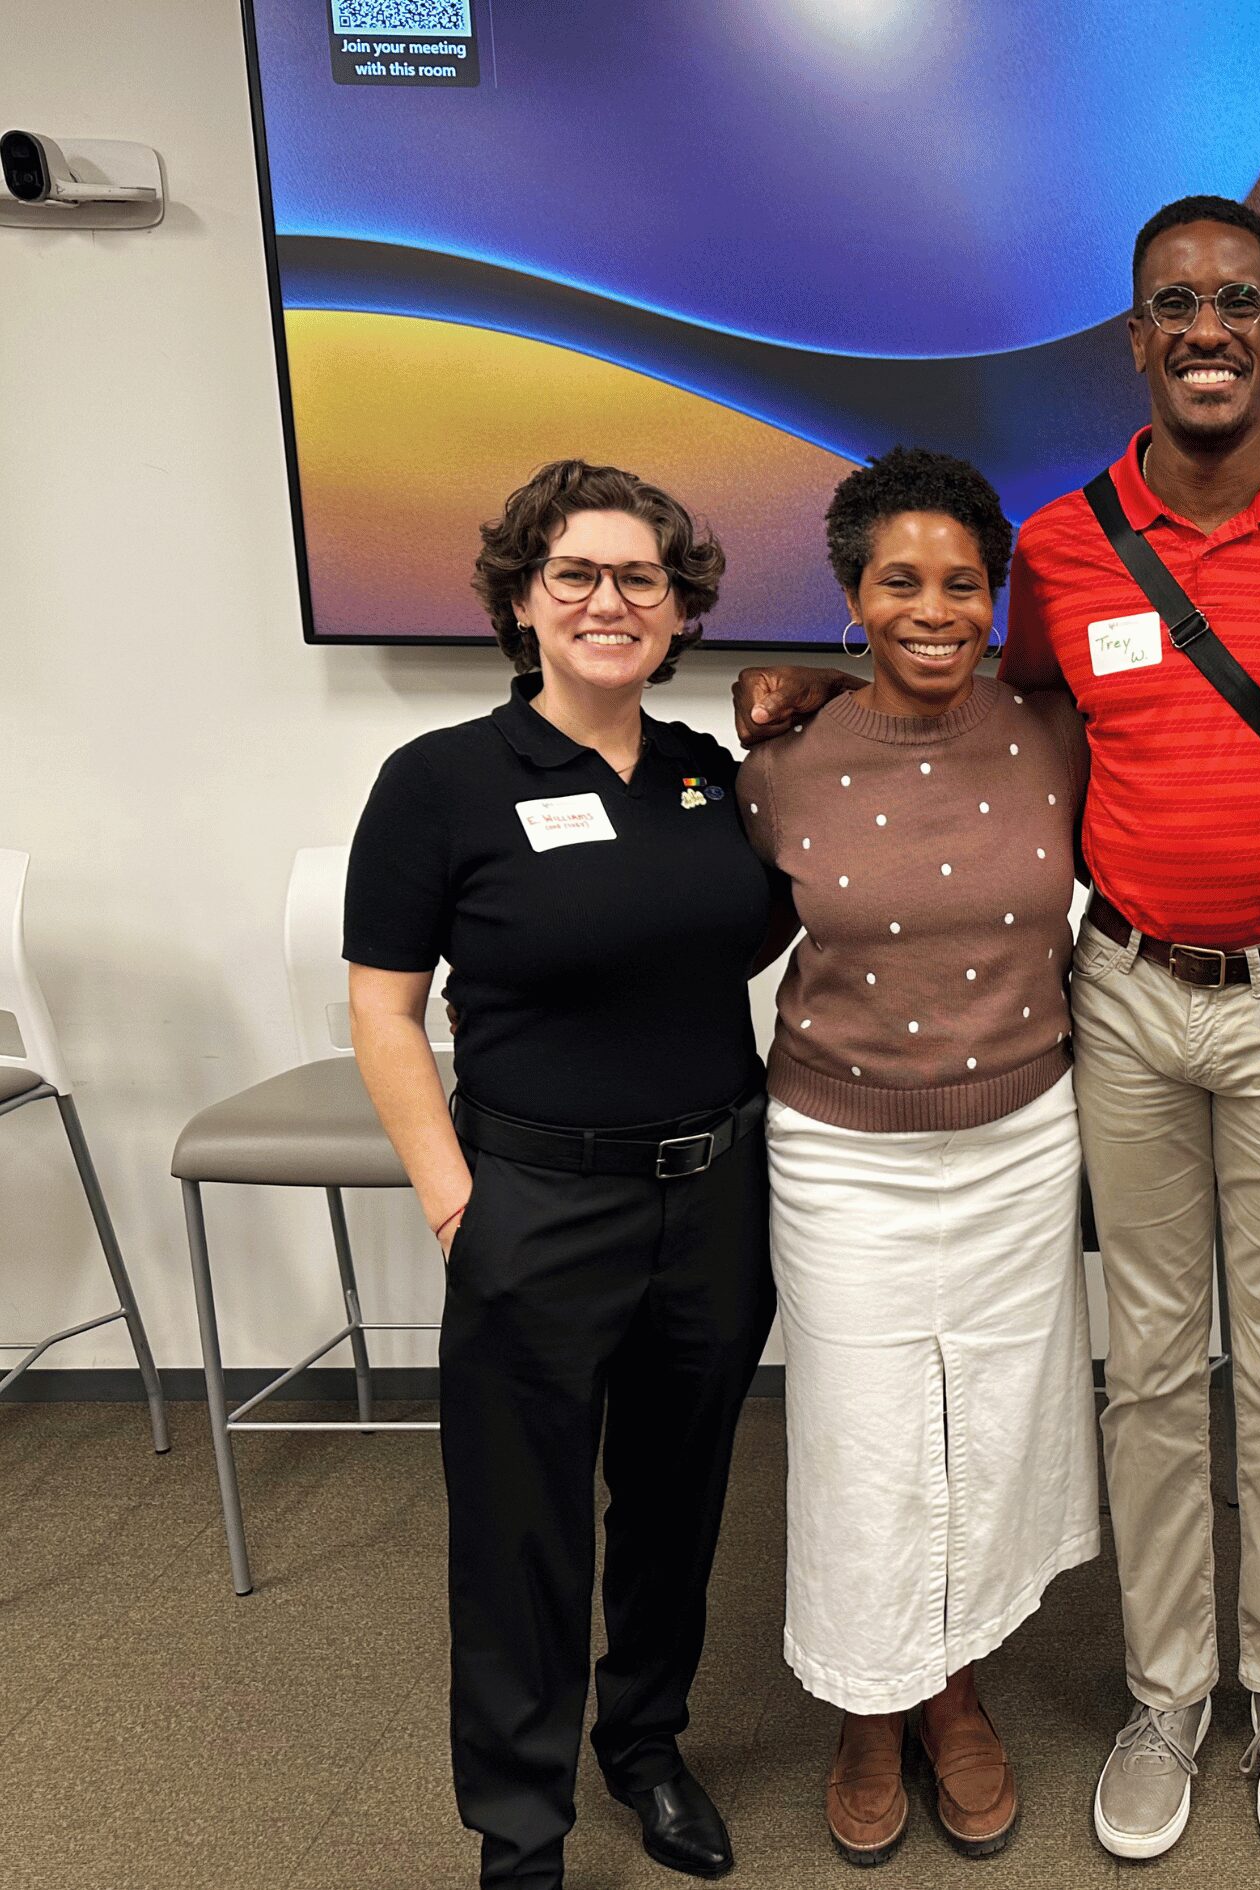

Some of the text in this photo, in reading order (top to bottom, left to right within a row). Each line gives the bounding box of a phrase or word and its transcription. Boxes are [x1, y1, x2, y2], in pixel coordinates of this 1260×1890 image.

[341, 39, 467, 58] Join your meeting
[354, 61, 457, 77] with this room
[1095, 634, 1131, 655] Trey
